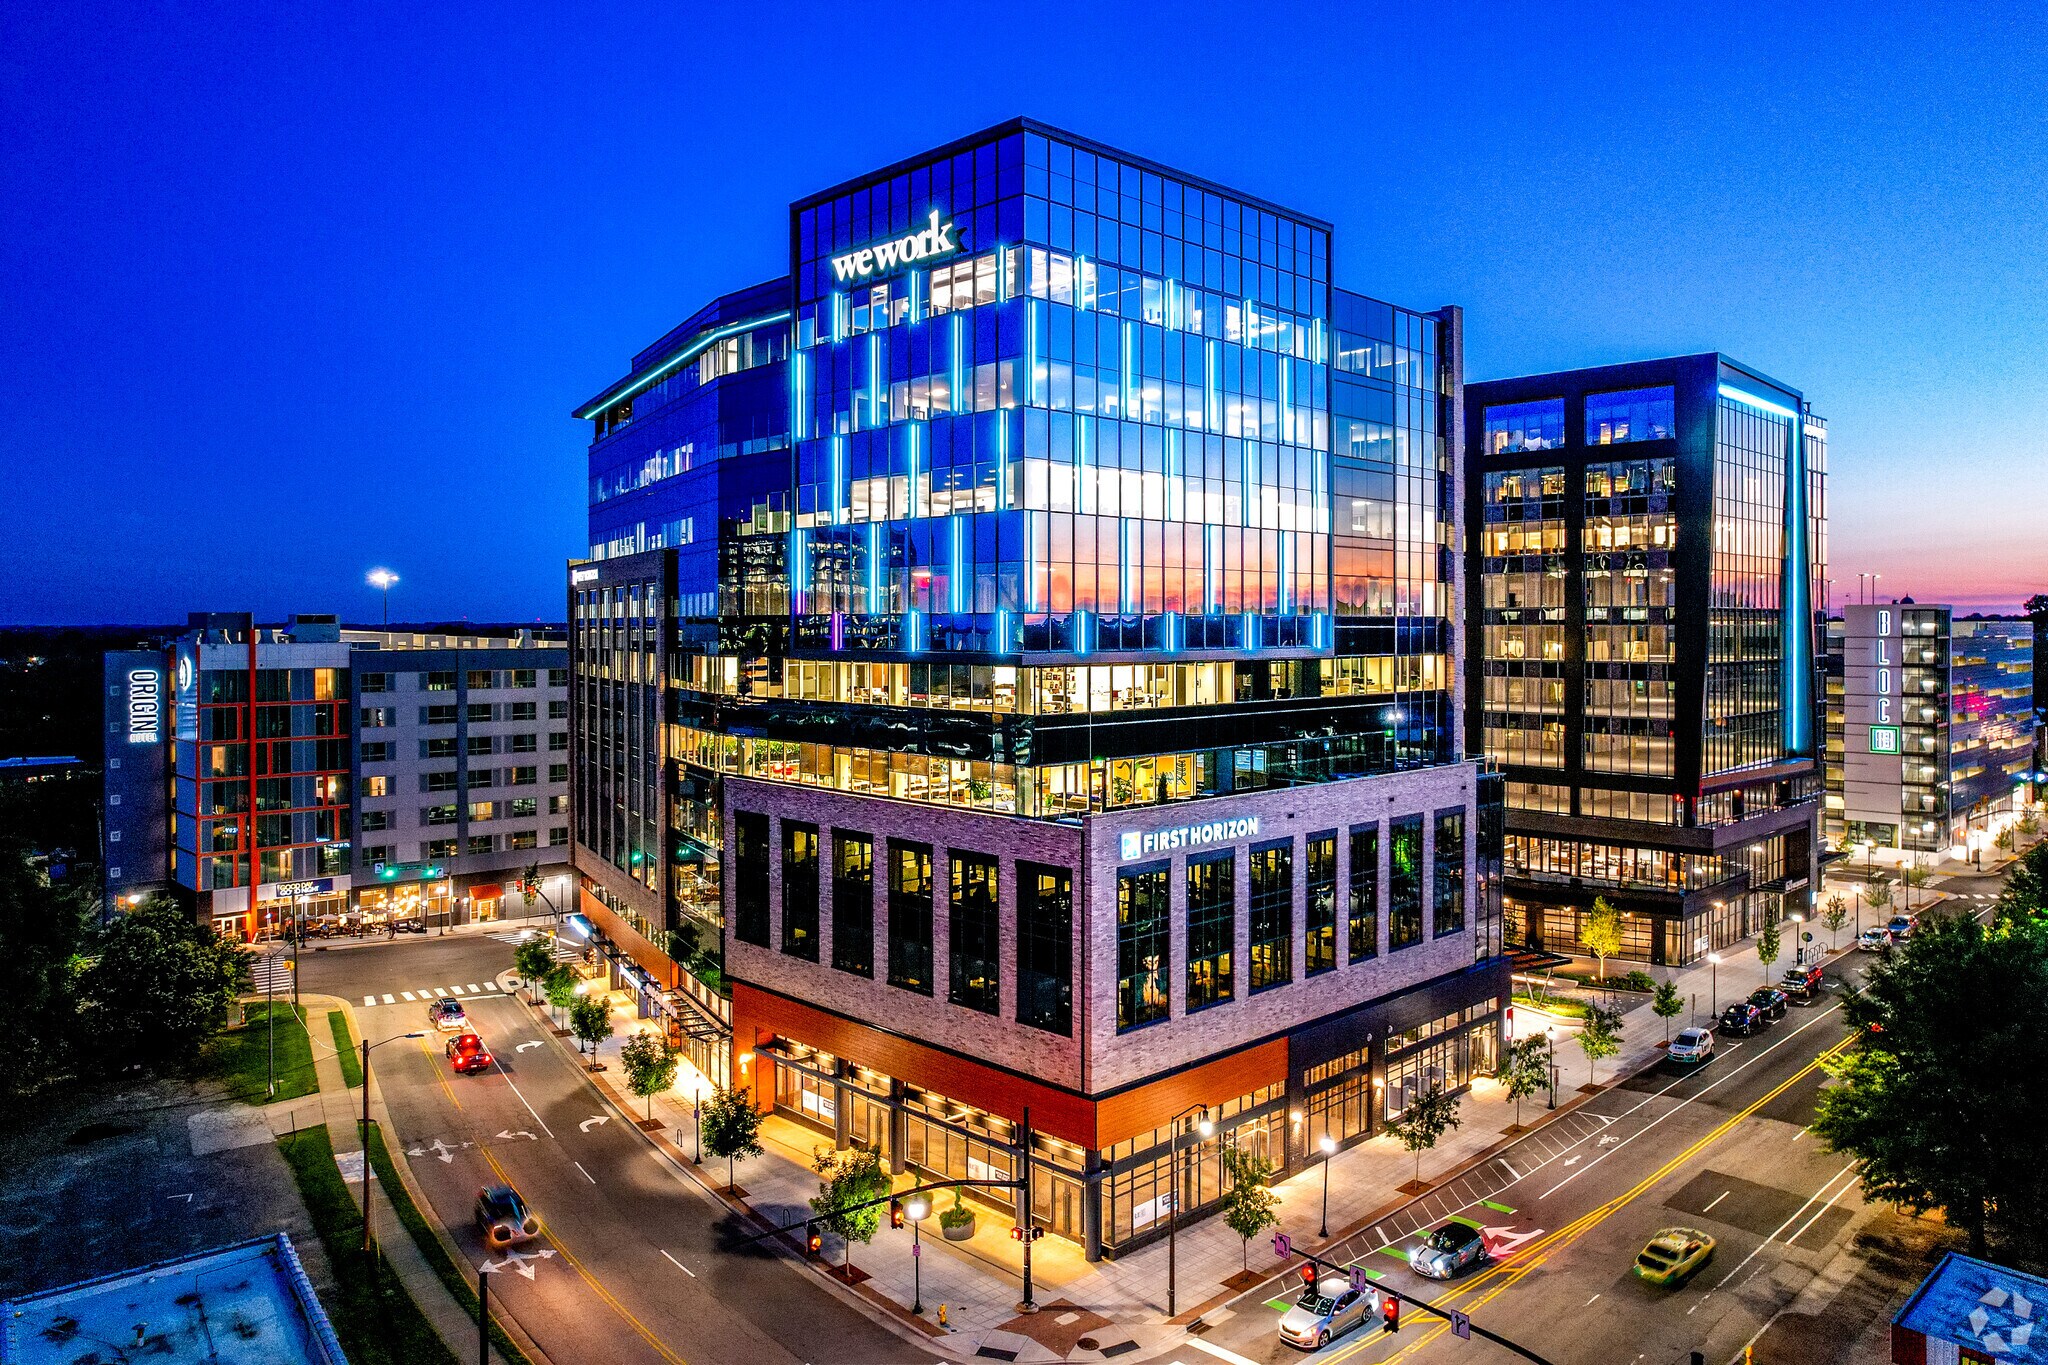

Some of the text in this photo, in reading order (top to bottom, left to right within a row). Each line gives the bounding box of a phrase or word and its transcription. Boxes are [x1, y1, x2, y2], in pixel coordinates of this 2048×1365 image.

[1878, 610, 1890, 724] BLOC
[129, 670, 158, 733] ORIGIN
[1143, 817, 1258, 853] FIRST HORIZON
[280, 883, 300, 891] GOOD
